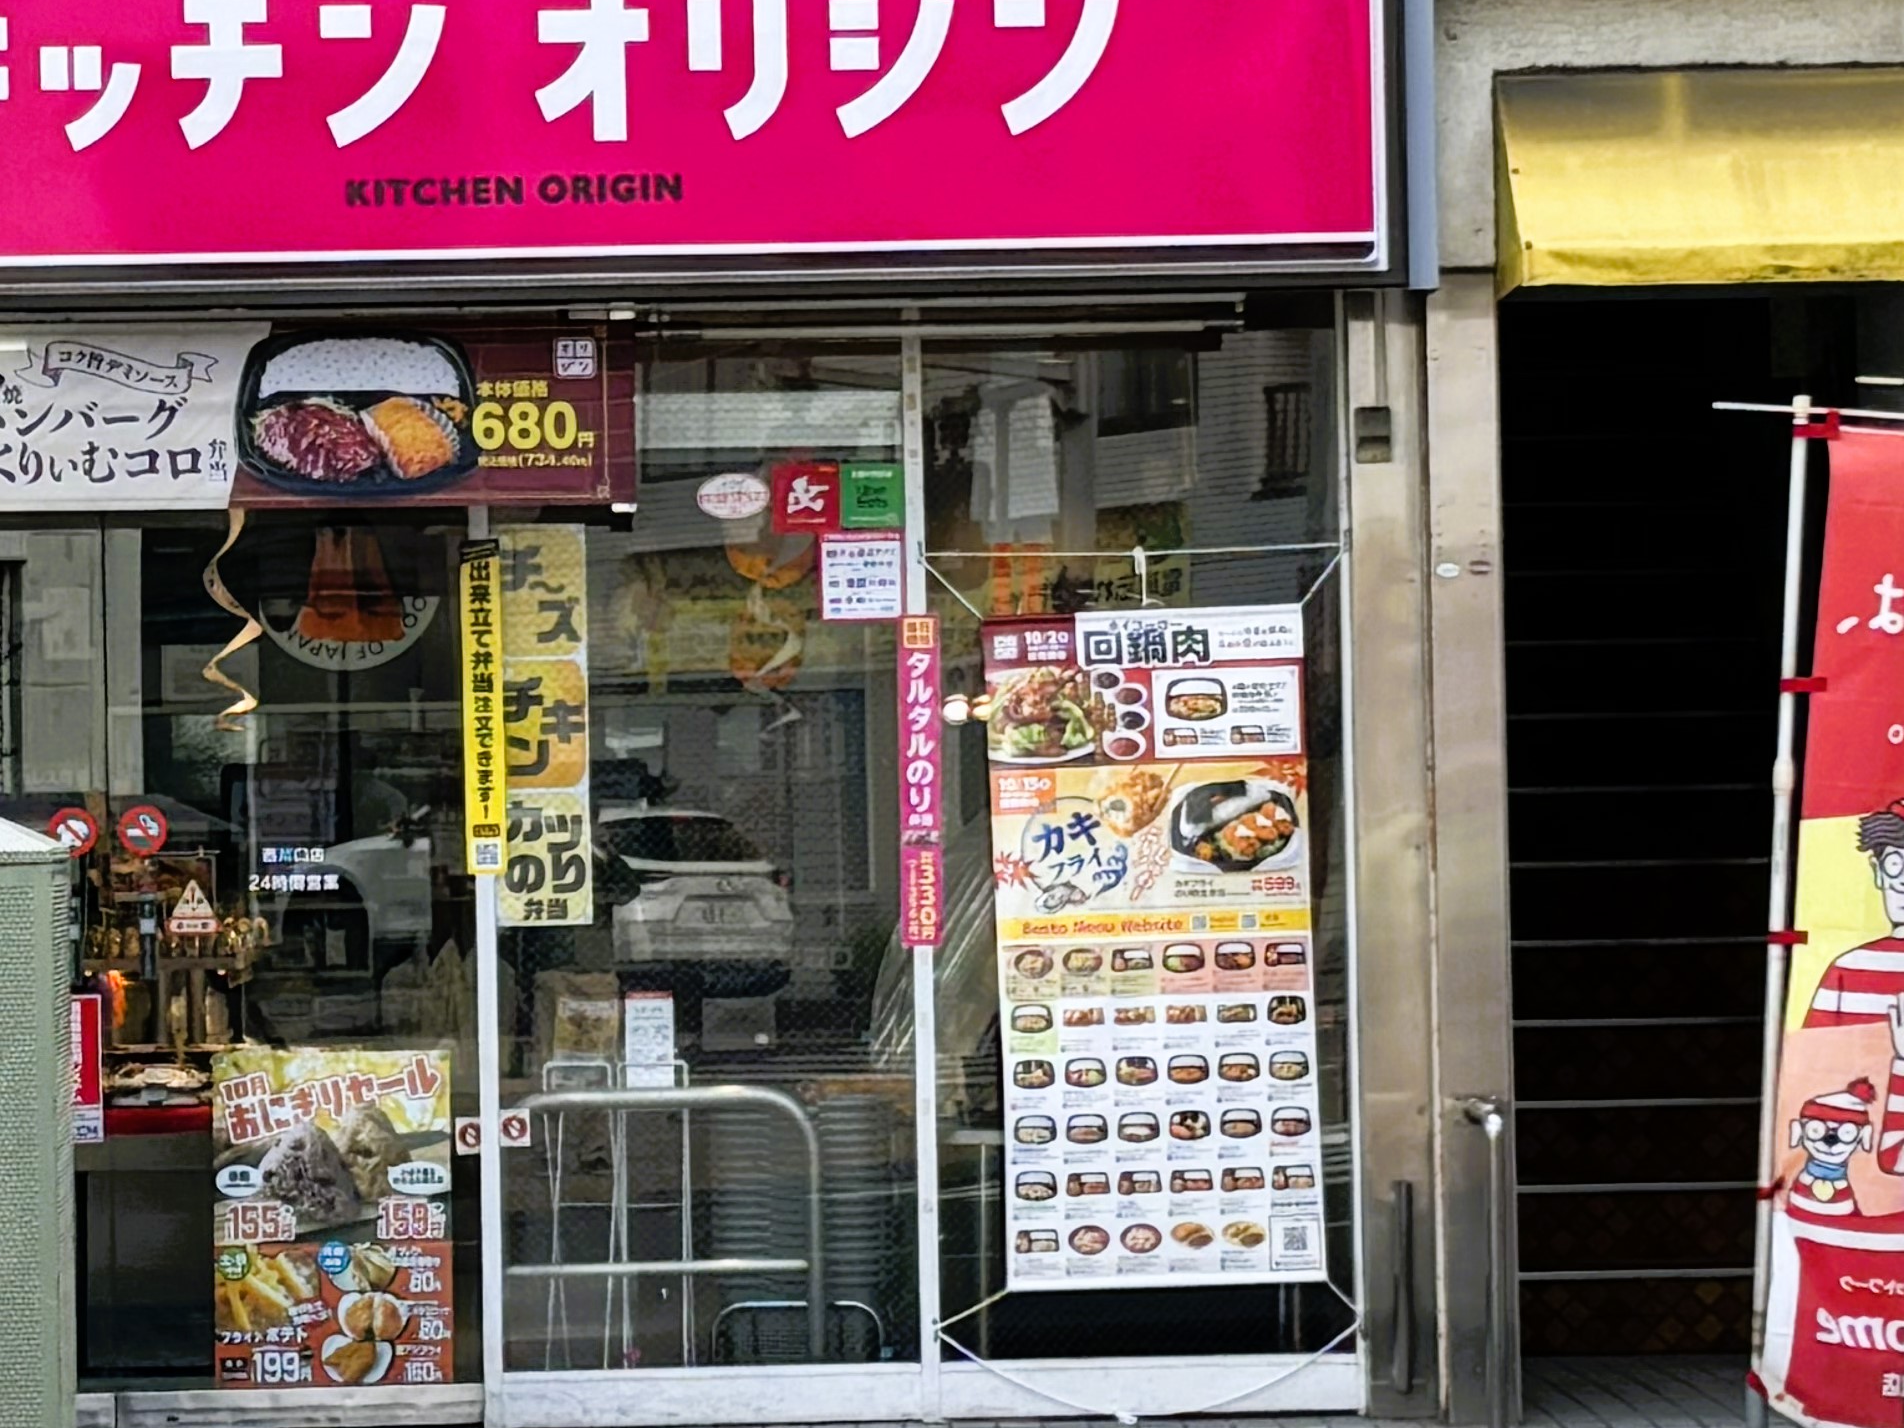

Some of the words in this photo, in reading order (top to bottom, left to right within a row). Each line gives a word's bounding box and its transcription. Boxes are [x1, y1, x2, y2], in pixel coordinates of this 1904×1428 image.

[344, 176, 525, 208] KITCHEN
[537, 173, 685, 206] ORIGIN
[475, 379, 549, 399] 本体価格
[1083, 626, 1211, 667] 回鍋肉
[225, 1054, 441, 1144] おにぎりセール
